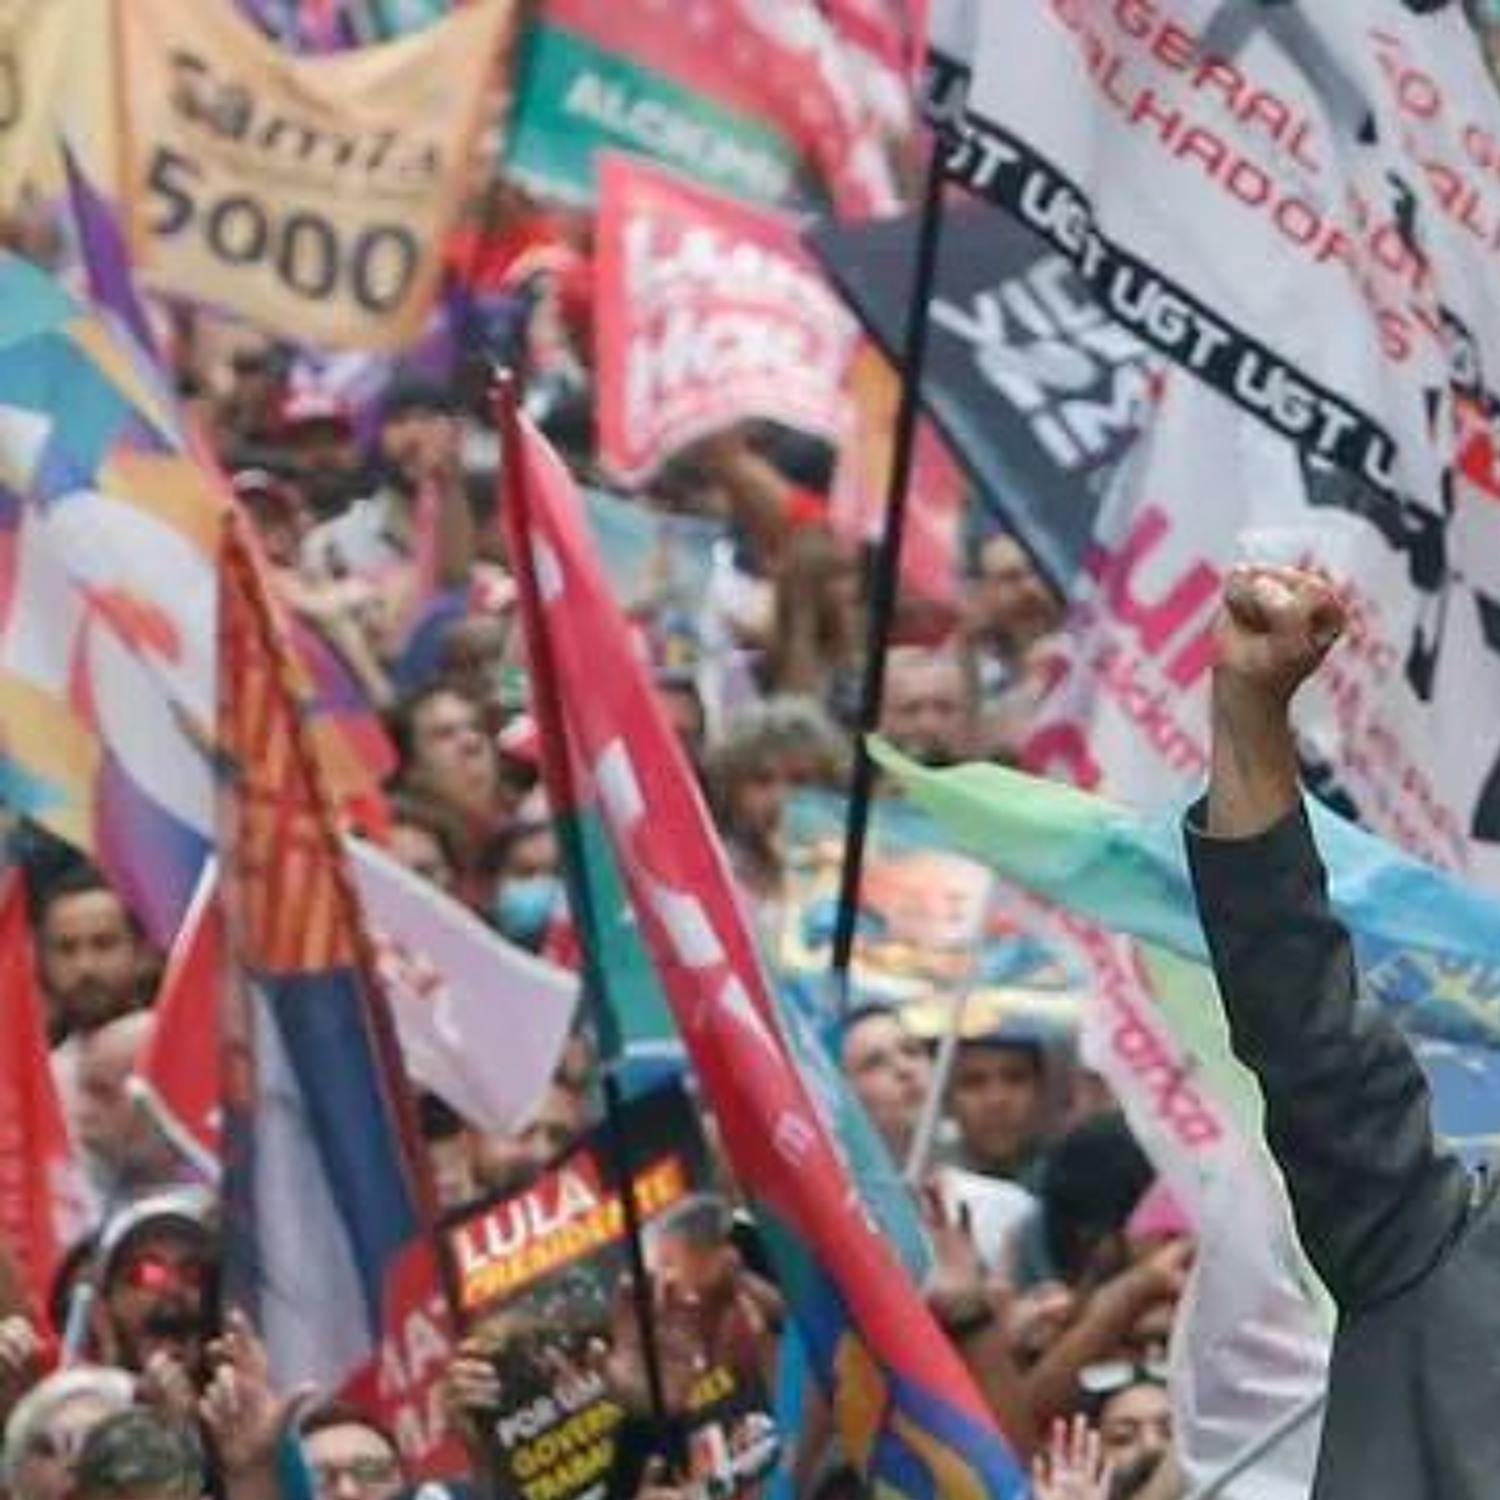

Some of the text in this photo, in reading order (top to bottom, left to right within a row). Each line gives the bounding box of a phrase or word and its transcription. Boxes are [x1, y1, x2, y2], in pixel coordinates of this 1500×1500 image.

[1112, 0, 1318, 174] GERAL
[146, 146, 422, 318] 5000
[1018, 170, 1106, 278] UGT
[1109, 265, 1234, 370] UGT
[1232, 352, 1358, 450] UGT
[452, 1166, 600, 1270] LULA
